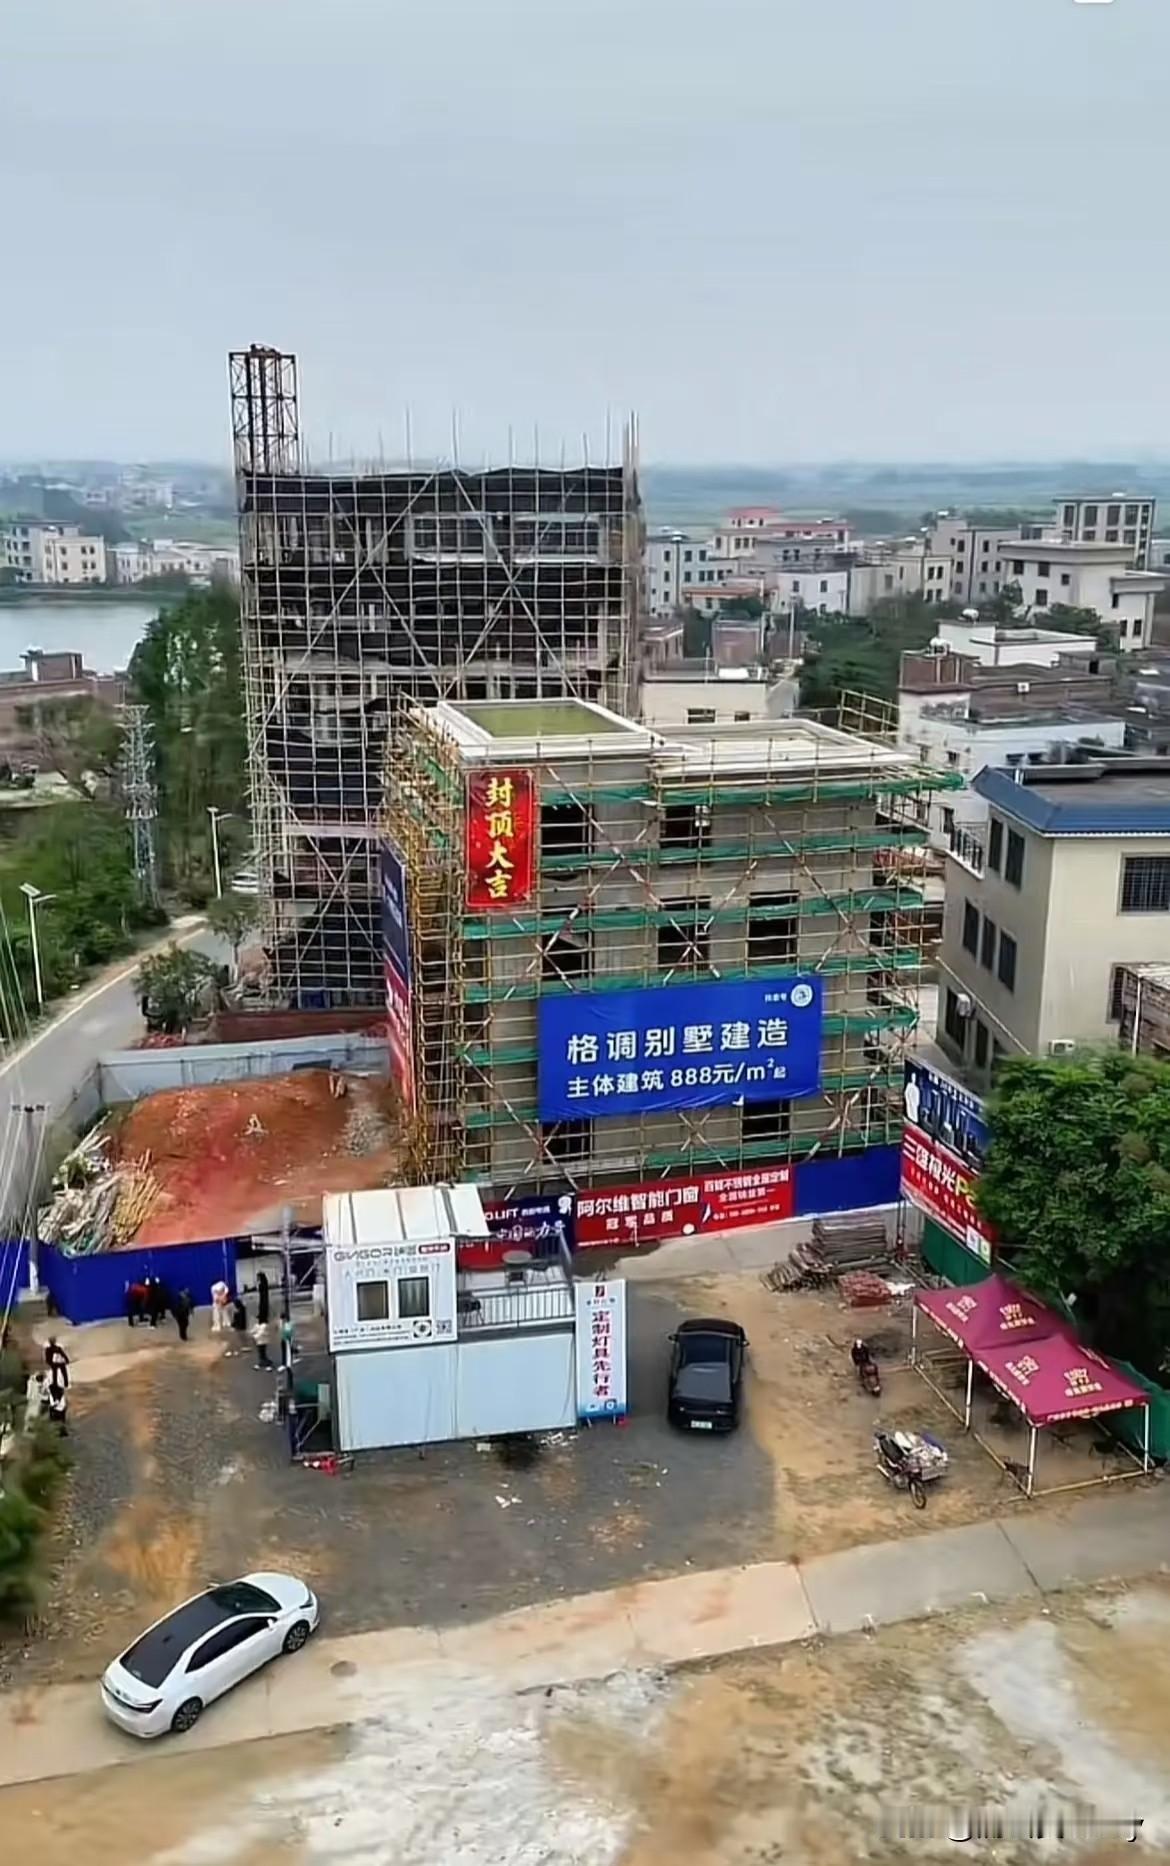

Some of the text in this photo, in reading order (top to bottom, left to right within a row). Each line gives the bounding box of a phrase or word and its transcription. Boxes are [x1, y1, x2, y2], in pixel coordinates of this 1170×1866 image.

[484, 777, 515, 899] 封顶大吉
[566, 1018, 788, 1065] 格调别墅建造
[566, 1069, 664, 1099] 主体建筑
[576, 1186, 700, 1218] 阿尔维智能门窗
